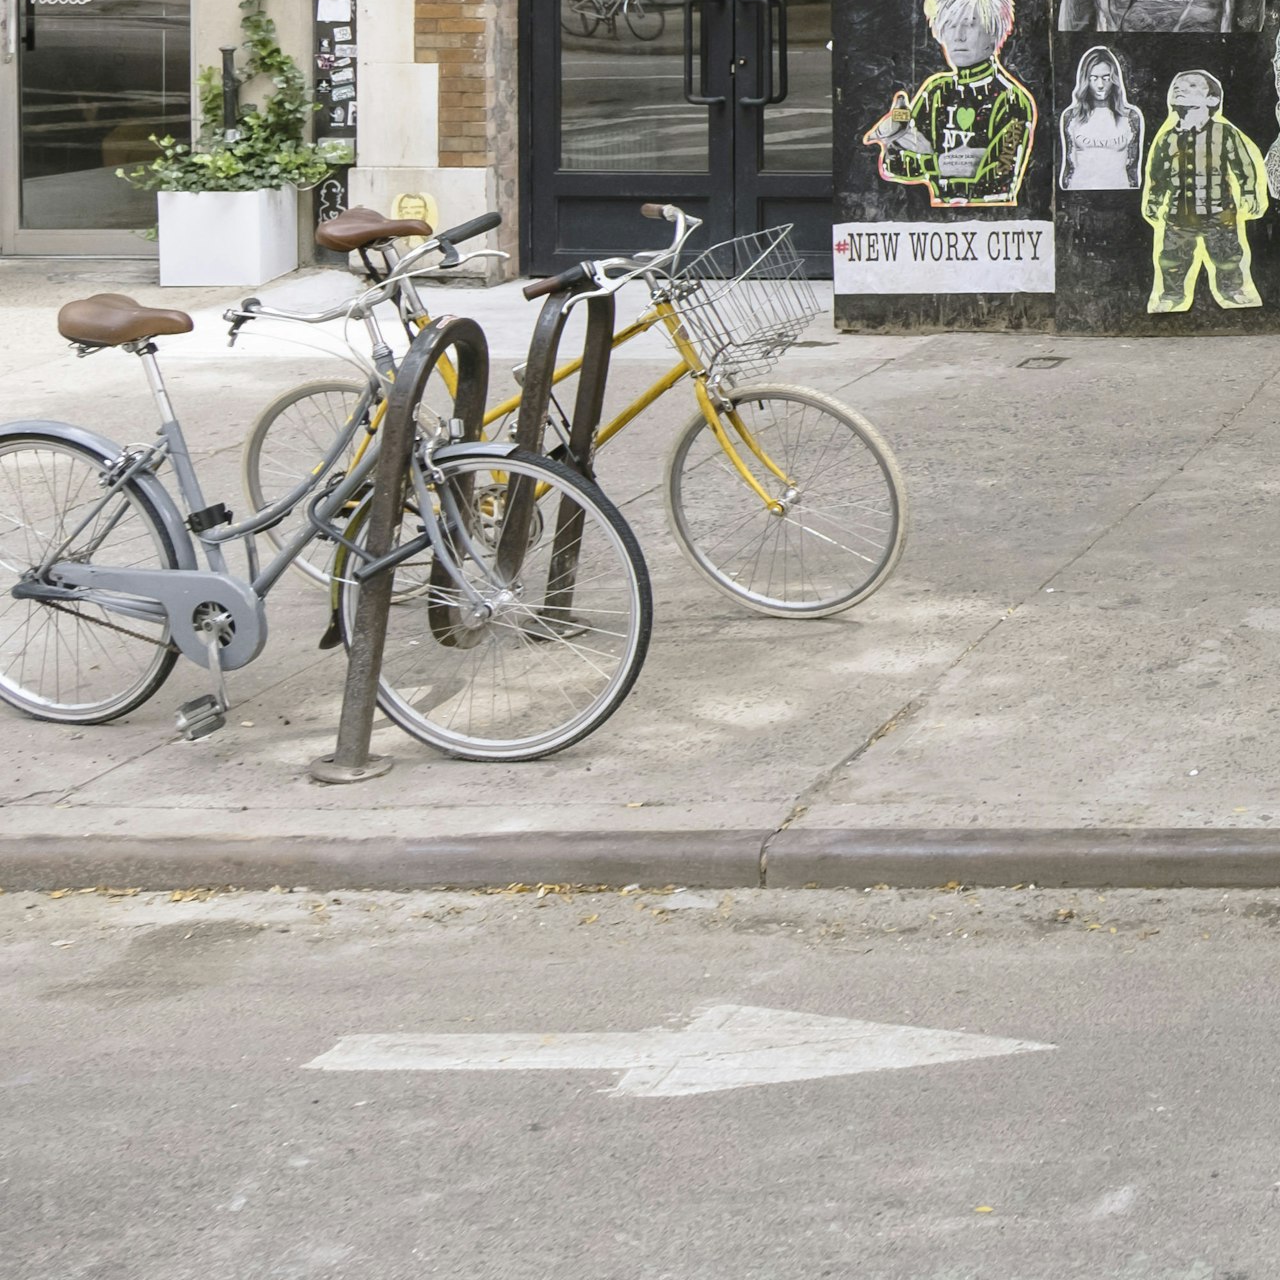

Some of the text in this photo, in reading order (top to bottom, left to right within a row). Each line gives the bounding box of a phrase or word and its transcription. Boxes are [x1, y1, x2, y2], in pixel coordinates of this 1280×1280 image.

[945, 105, 957, 128] I
[942, 129, 976, 151] NY
[834, 230, 1043, 262] #NEW WORX CITY
